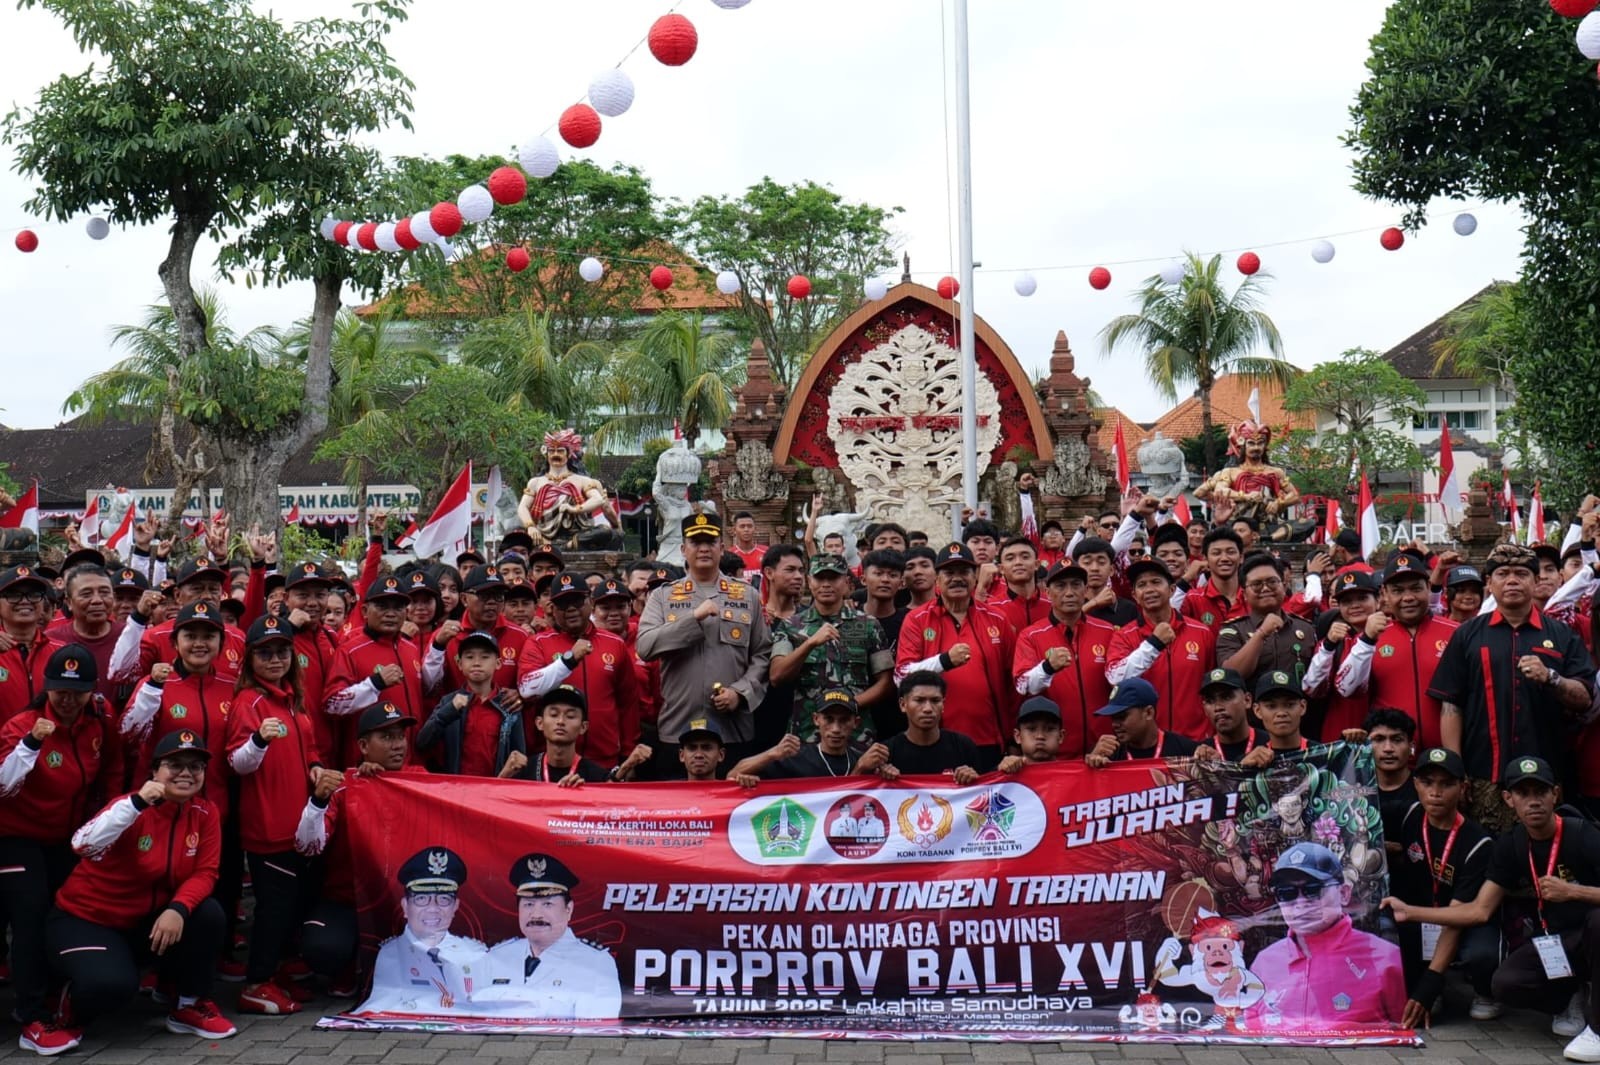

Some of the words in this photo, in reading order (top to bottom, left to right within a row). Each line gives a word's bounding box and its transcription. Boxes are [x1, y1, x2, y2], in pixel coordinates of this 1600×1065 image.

[139, 495, 165, 509] MAH
[280, 495, 315, 508] ERAH
[319, 493, 400, 508] KABUATEN
[724, 601, 748, 609] POLRI
[1059, 783, 1185, 824] TABANAN
[547, 819, 595, 829] NANGUN
[596, 821, 617, 830] SAT
[618, 821, 657, 830] KERTHI
[659, 821, 687, 830] LOKA
[689, 820, 713, 829] BALI
[1066, 797, 1213, 848] JUARA
[1225, 793, 1238, 817] !
[626, 838, 656, 846] ERA
[897, 850, 916, 858] KONI
[917, 849, 955, 857] TABANAN
[603, 883, 801, 912] PELEPASAN
[804, 878, 998, 912] KONTINGEN
[1006, 870, 1166, 906] TABANAN
[722, 924, 802, 949] PEKAN
[811, 920, 940, 949] OLAHRAGA
[949, 917, 1061, 946] PROVINSI
[634, 949, 883, 996] PORPROV
[907, 945, 1033, 995] BALI
[1055, 941, 1146, 991] XVI
[692, 999, 766, 1013] TAHUN
[951, 995, 1093, 1013] Samudhaya
